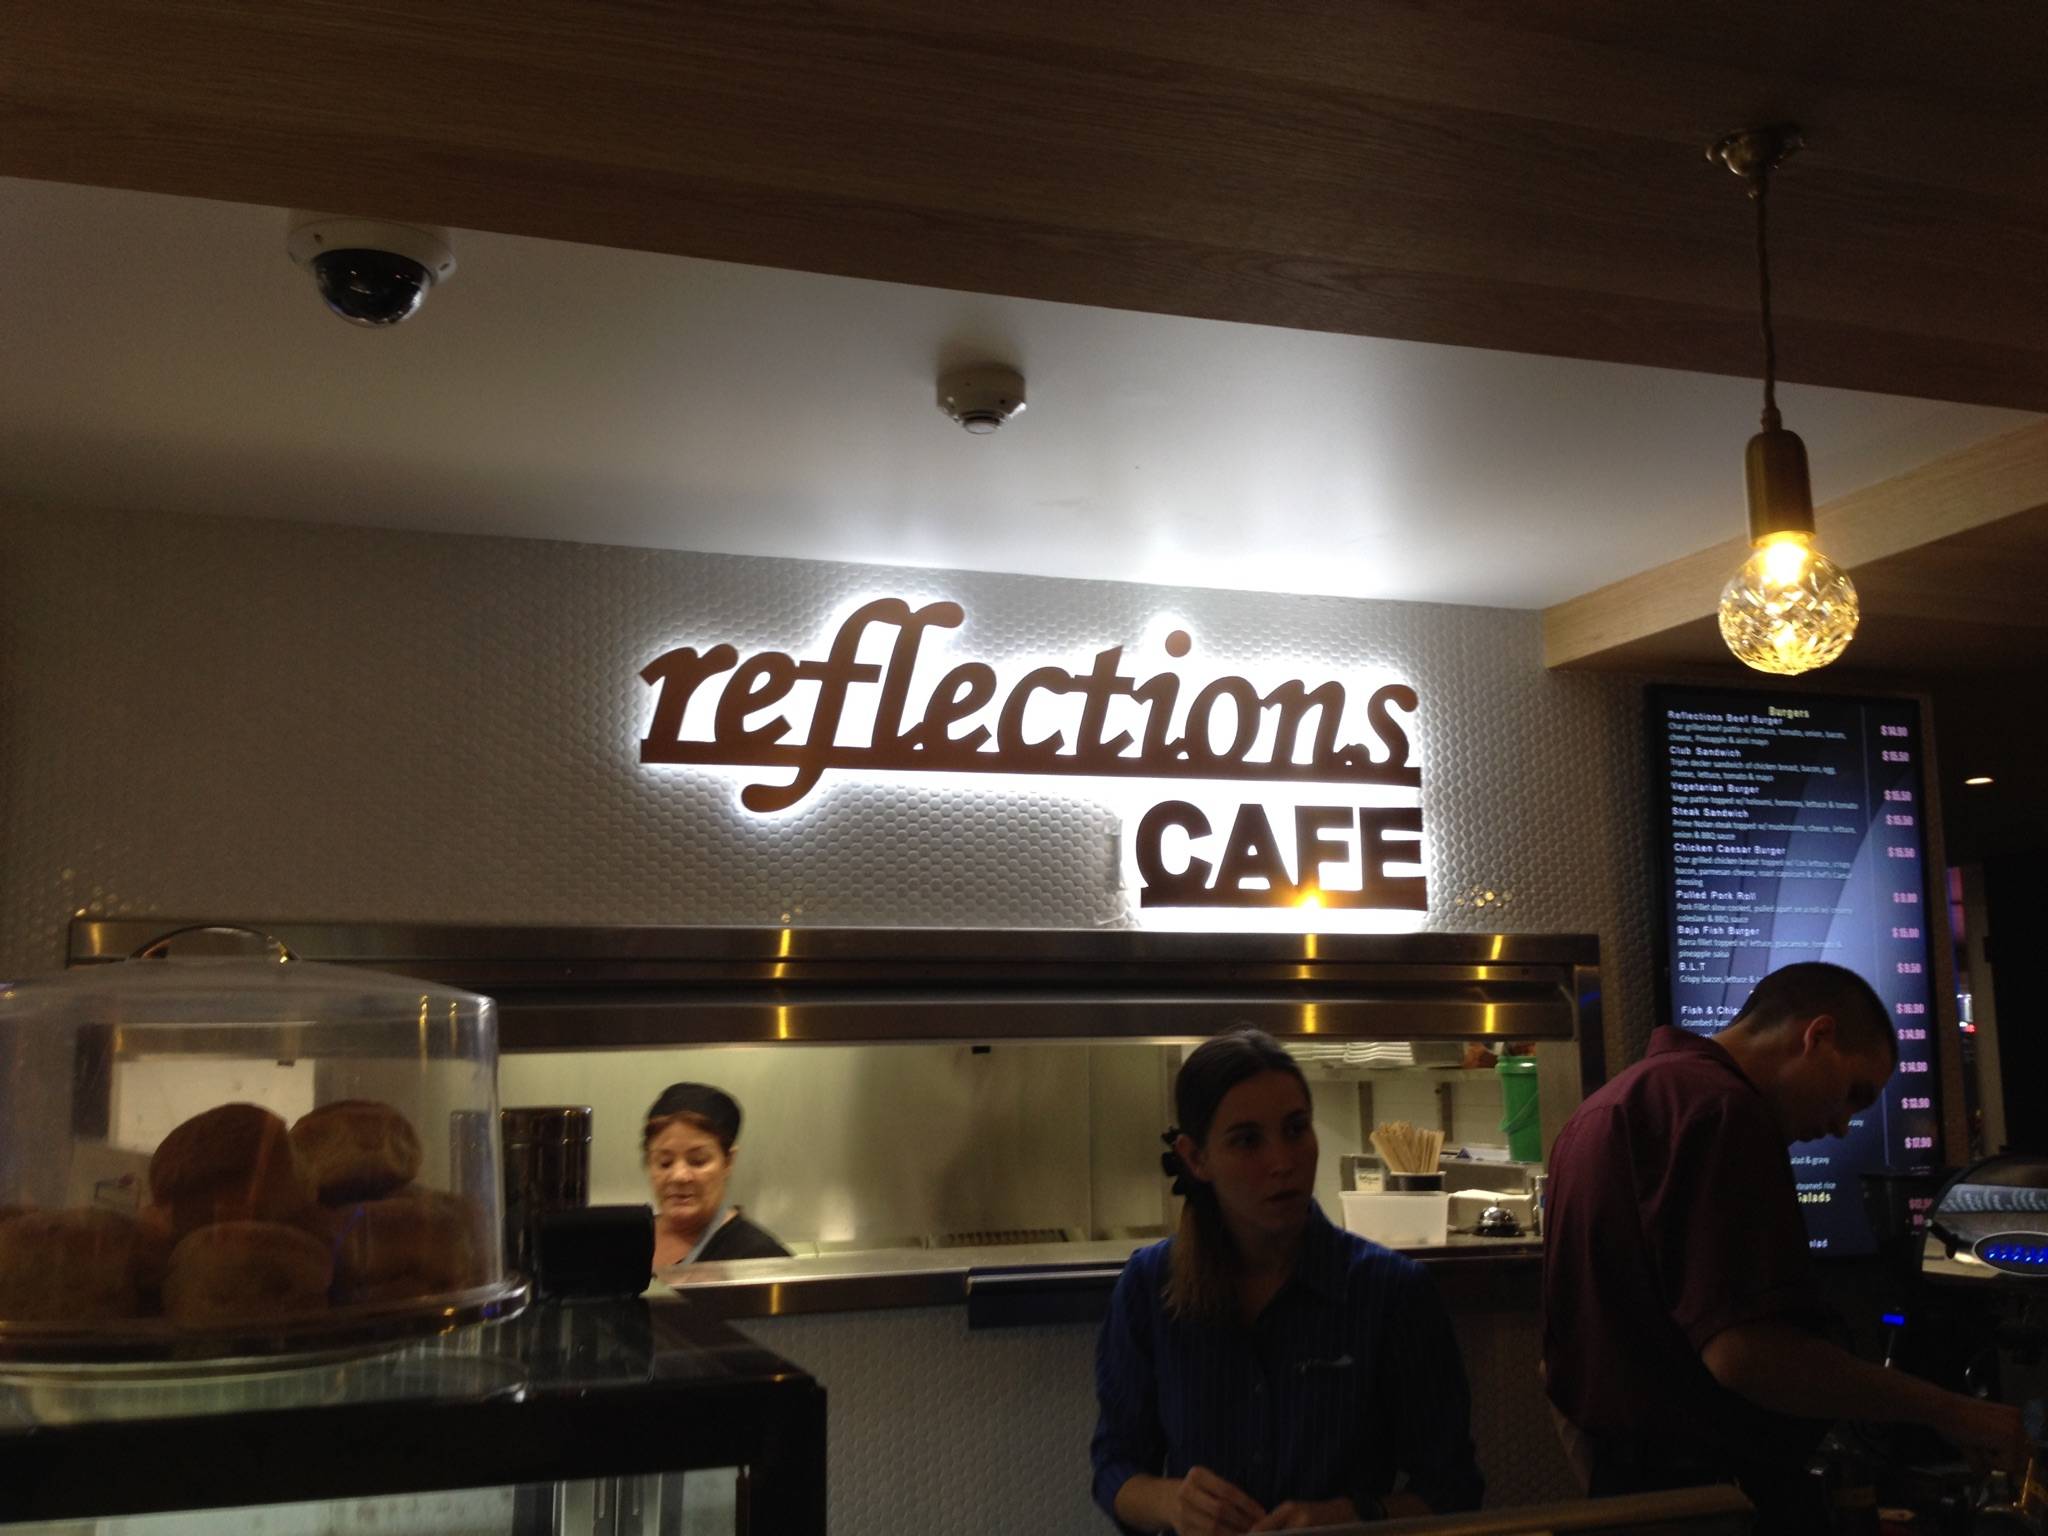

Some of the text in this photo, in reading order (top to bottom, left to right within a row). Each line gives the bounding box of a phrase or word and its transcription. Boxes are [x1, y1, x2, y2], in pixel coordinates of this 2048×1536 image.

[640, 597, 1422, 813] reflections
[1668, 711, 1783, 726] Reflections Beef Burger
[1769, 706, 1810, 719] Burgers
[1669, 746, 1741, 758] Club Sandwich
[1672, 783, 1760, 795] Vegetarian Burger
[1672, 807, 1749, 819] Steak Sandwich
[1136, 799, 1424, 898] CAFE
[1674, 843, 1786, 857] Chicken Caesar Burger
[1676, 890, 1757, 901] Pulled Pork Roll
[1678, 926, 1760, 937] Baja Fish Burger
[1679, 962, 1706, 972] B.L.T
[1680, 975, 1701, 984] Crispy
[1748, 975, 1756, 984] &
[1681, 1006, 1742, 1017] Fish & Chip
[1682, 1018, 1714, 1027] Crumbed
[1805, 1156, 1812, 1165] &
[1813, 1157, 1830, 1166] gravy
